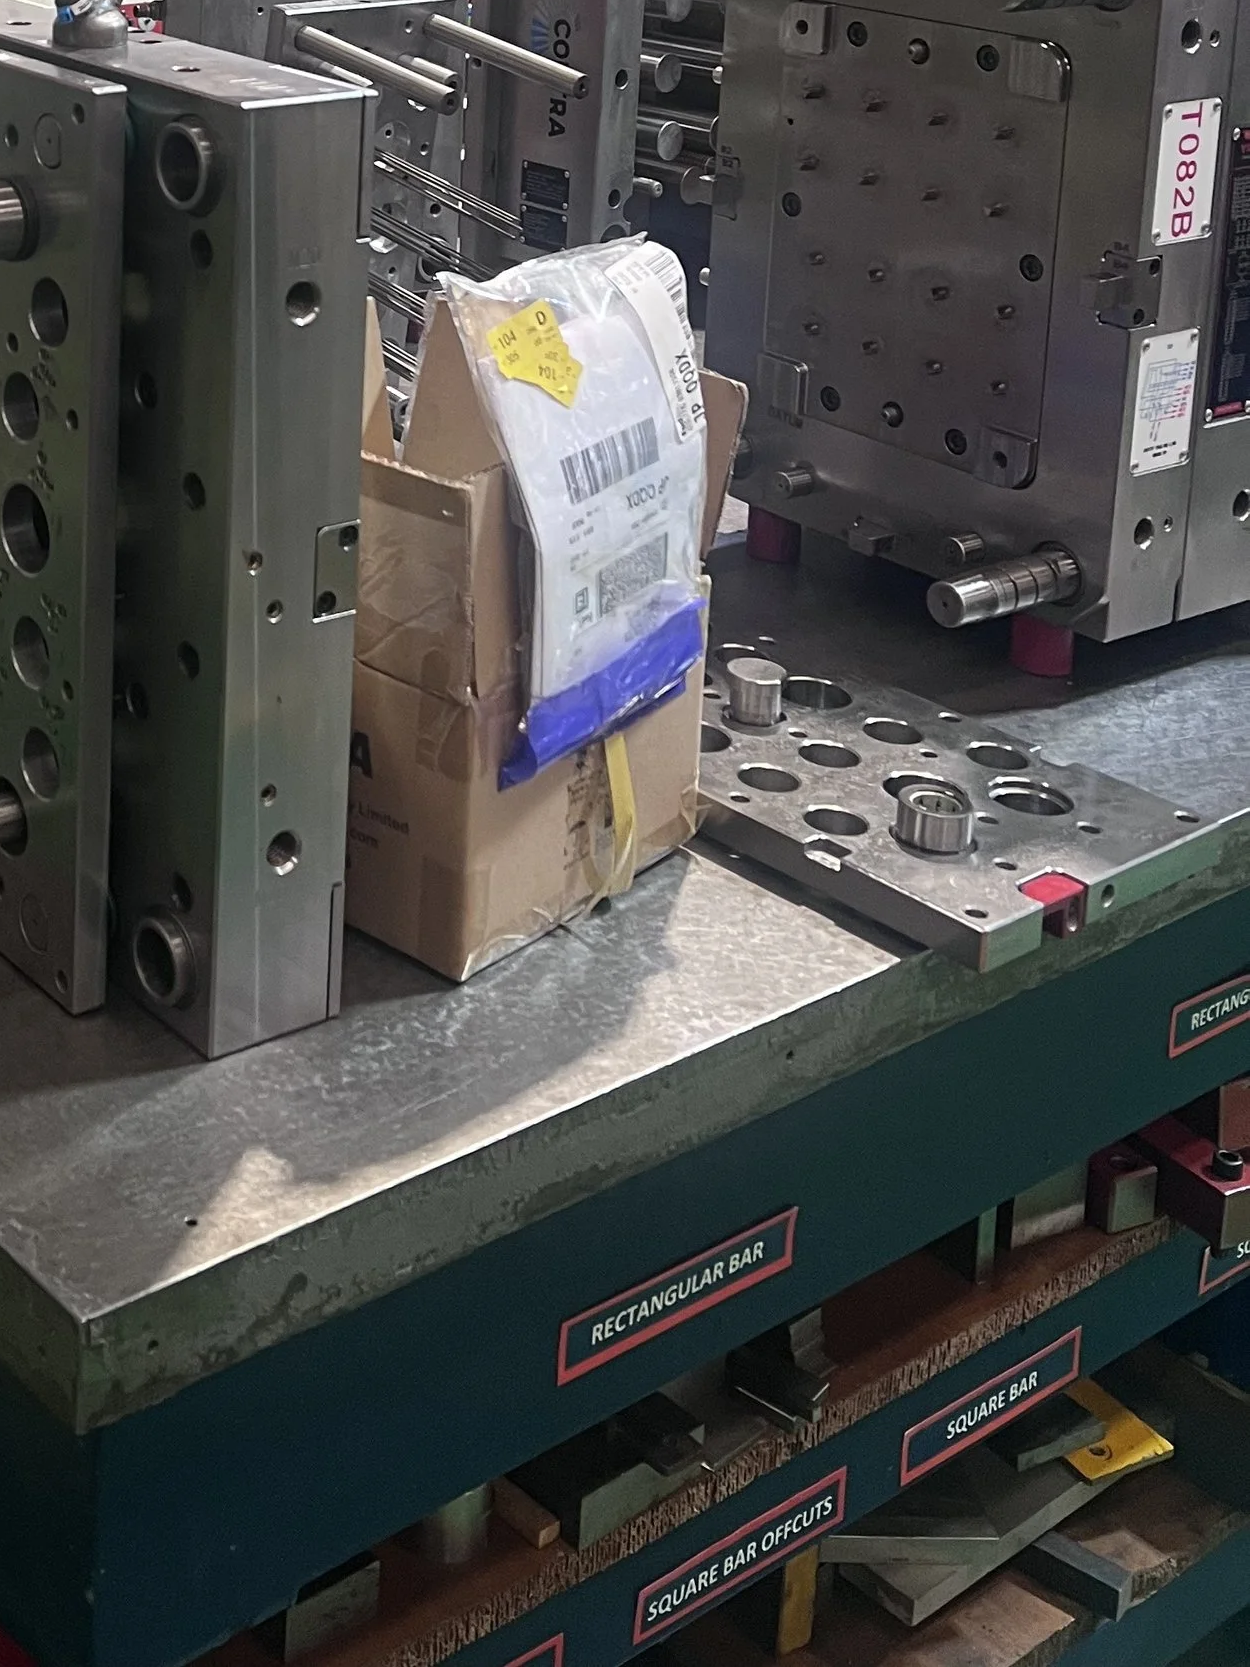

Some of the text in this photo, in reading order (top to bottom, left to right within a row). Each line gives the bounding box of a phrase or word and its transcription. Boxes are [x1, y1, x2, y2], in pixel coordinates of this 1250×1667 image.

[548, 18, 571, 138] CORA
[1171, 101, 1204, 238] T082B
[357, 800, 410, 835] Limited
[591, 1240, 764, 1346] RECTANGULAR BAR
[946, 1370, 1038, 1440] SQUARE BAR
[647, 1495, 833, 1622] SQUARE BAR OFFCUTS
